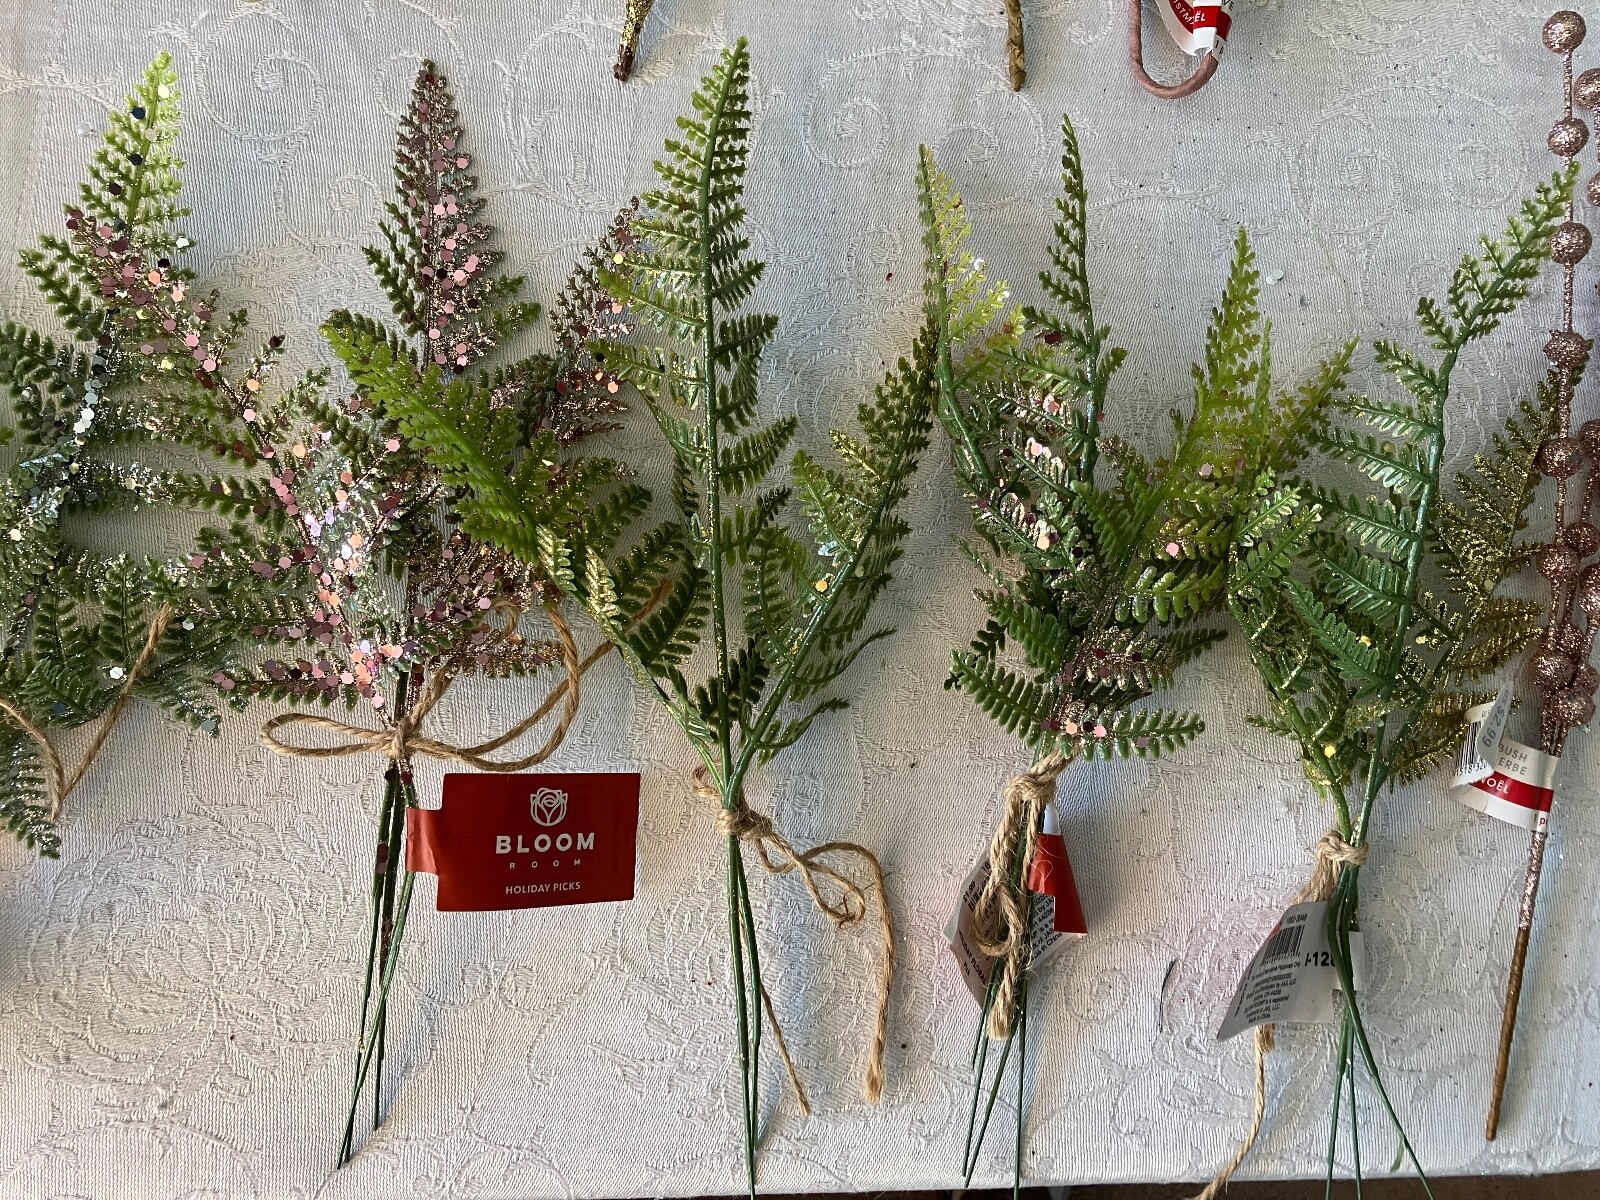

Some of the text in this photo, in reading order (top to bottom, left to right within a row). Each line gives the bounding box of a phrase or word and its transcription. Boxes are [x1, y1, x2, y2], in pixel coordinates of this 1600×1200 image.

[1482, 705, 1505, 748] $2.99
[1498, 757, 1527, 775] ERBE
[495, 832, 595, 854] BLOOM
[509, 858, 581, 870] ROOM
[505, 881, 581, 895] HOLIDAY PICKS
